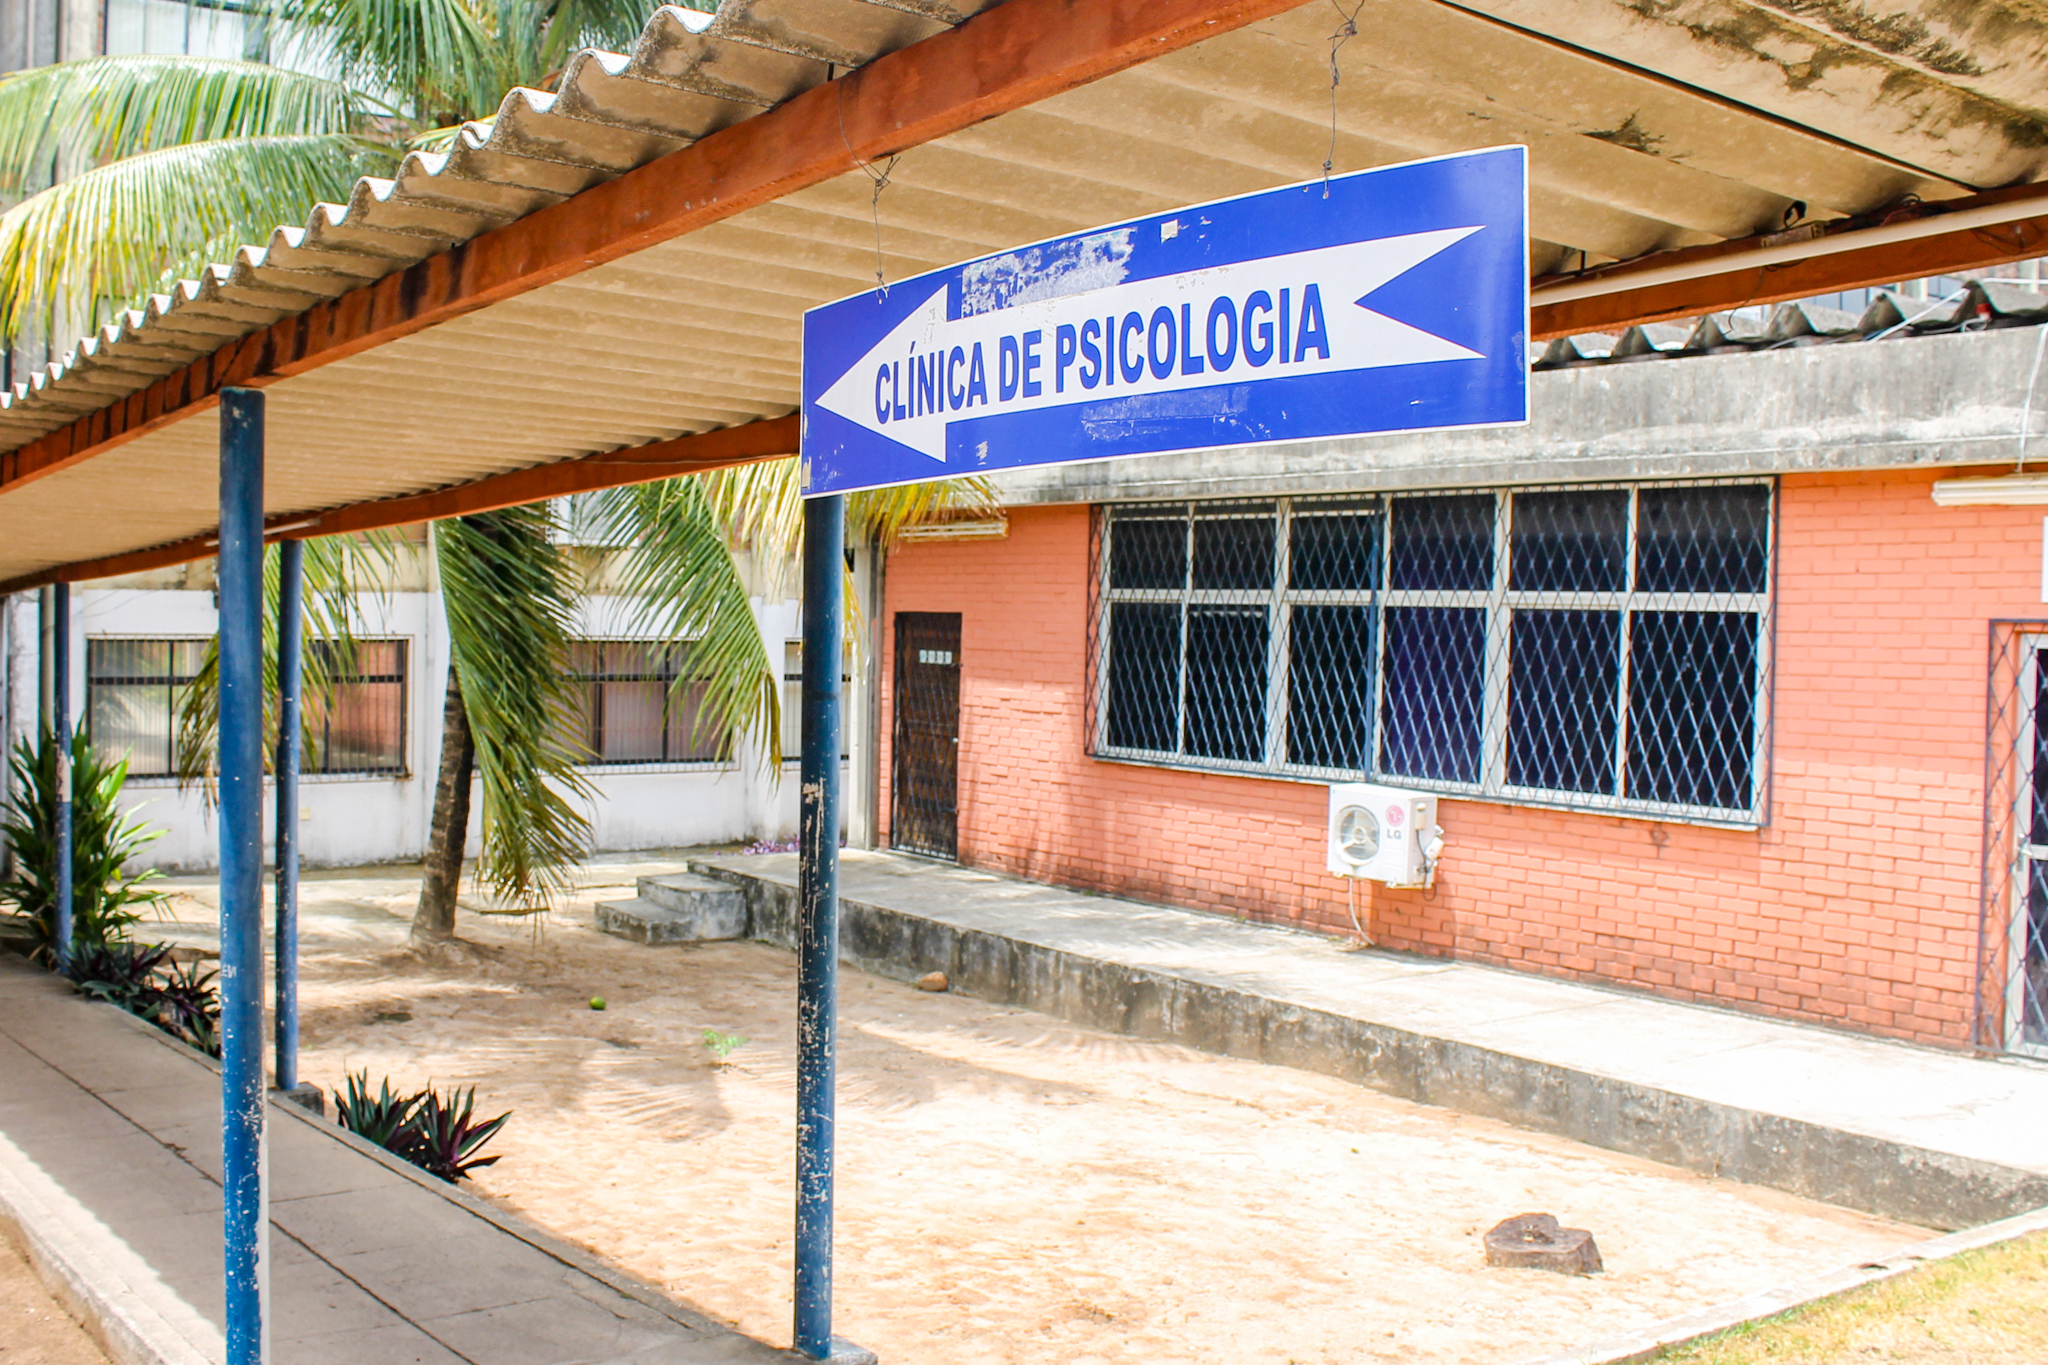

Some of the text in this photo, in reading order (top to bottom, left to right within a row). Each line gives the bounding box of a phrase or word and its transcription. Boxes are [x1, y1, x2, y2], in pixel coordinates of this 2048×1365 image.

[875, 283, 1331, 425] CLÍNICA DE PSICOLOGIA
[1386, 829, 1402, 840] LG
